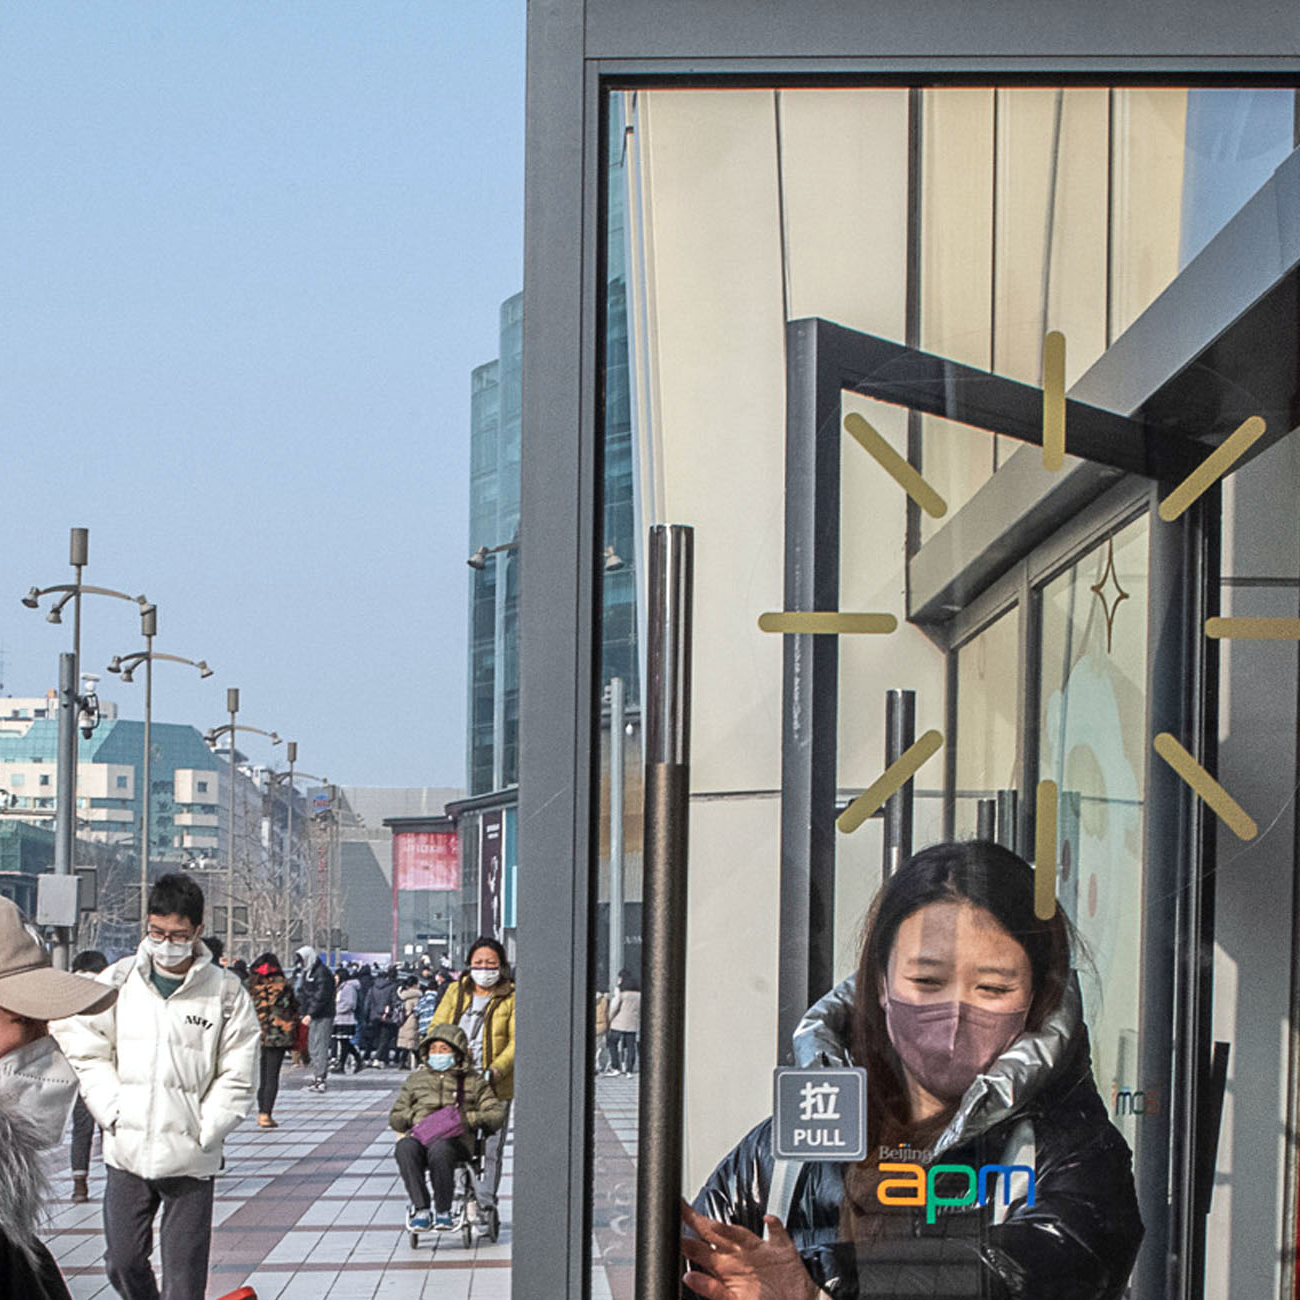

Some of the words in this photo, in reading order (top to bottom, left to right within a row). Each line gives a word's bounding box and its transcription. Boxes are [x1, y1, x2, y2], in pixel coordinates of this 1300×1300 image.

[799, 1081, 841, 1121] 拉
[793, 1128, 846, 1147] PULL
[878, 1143, 933, 1163] Beijing
[876, 1163, 1036, 1225] apm
